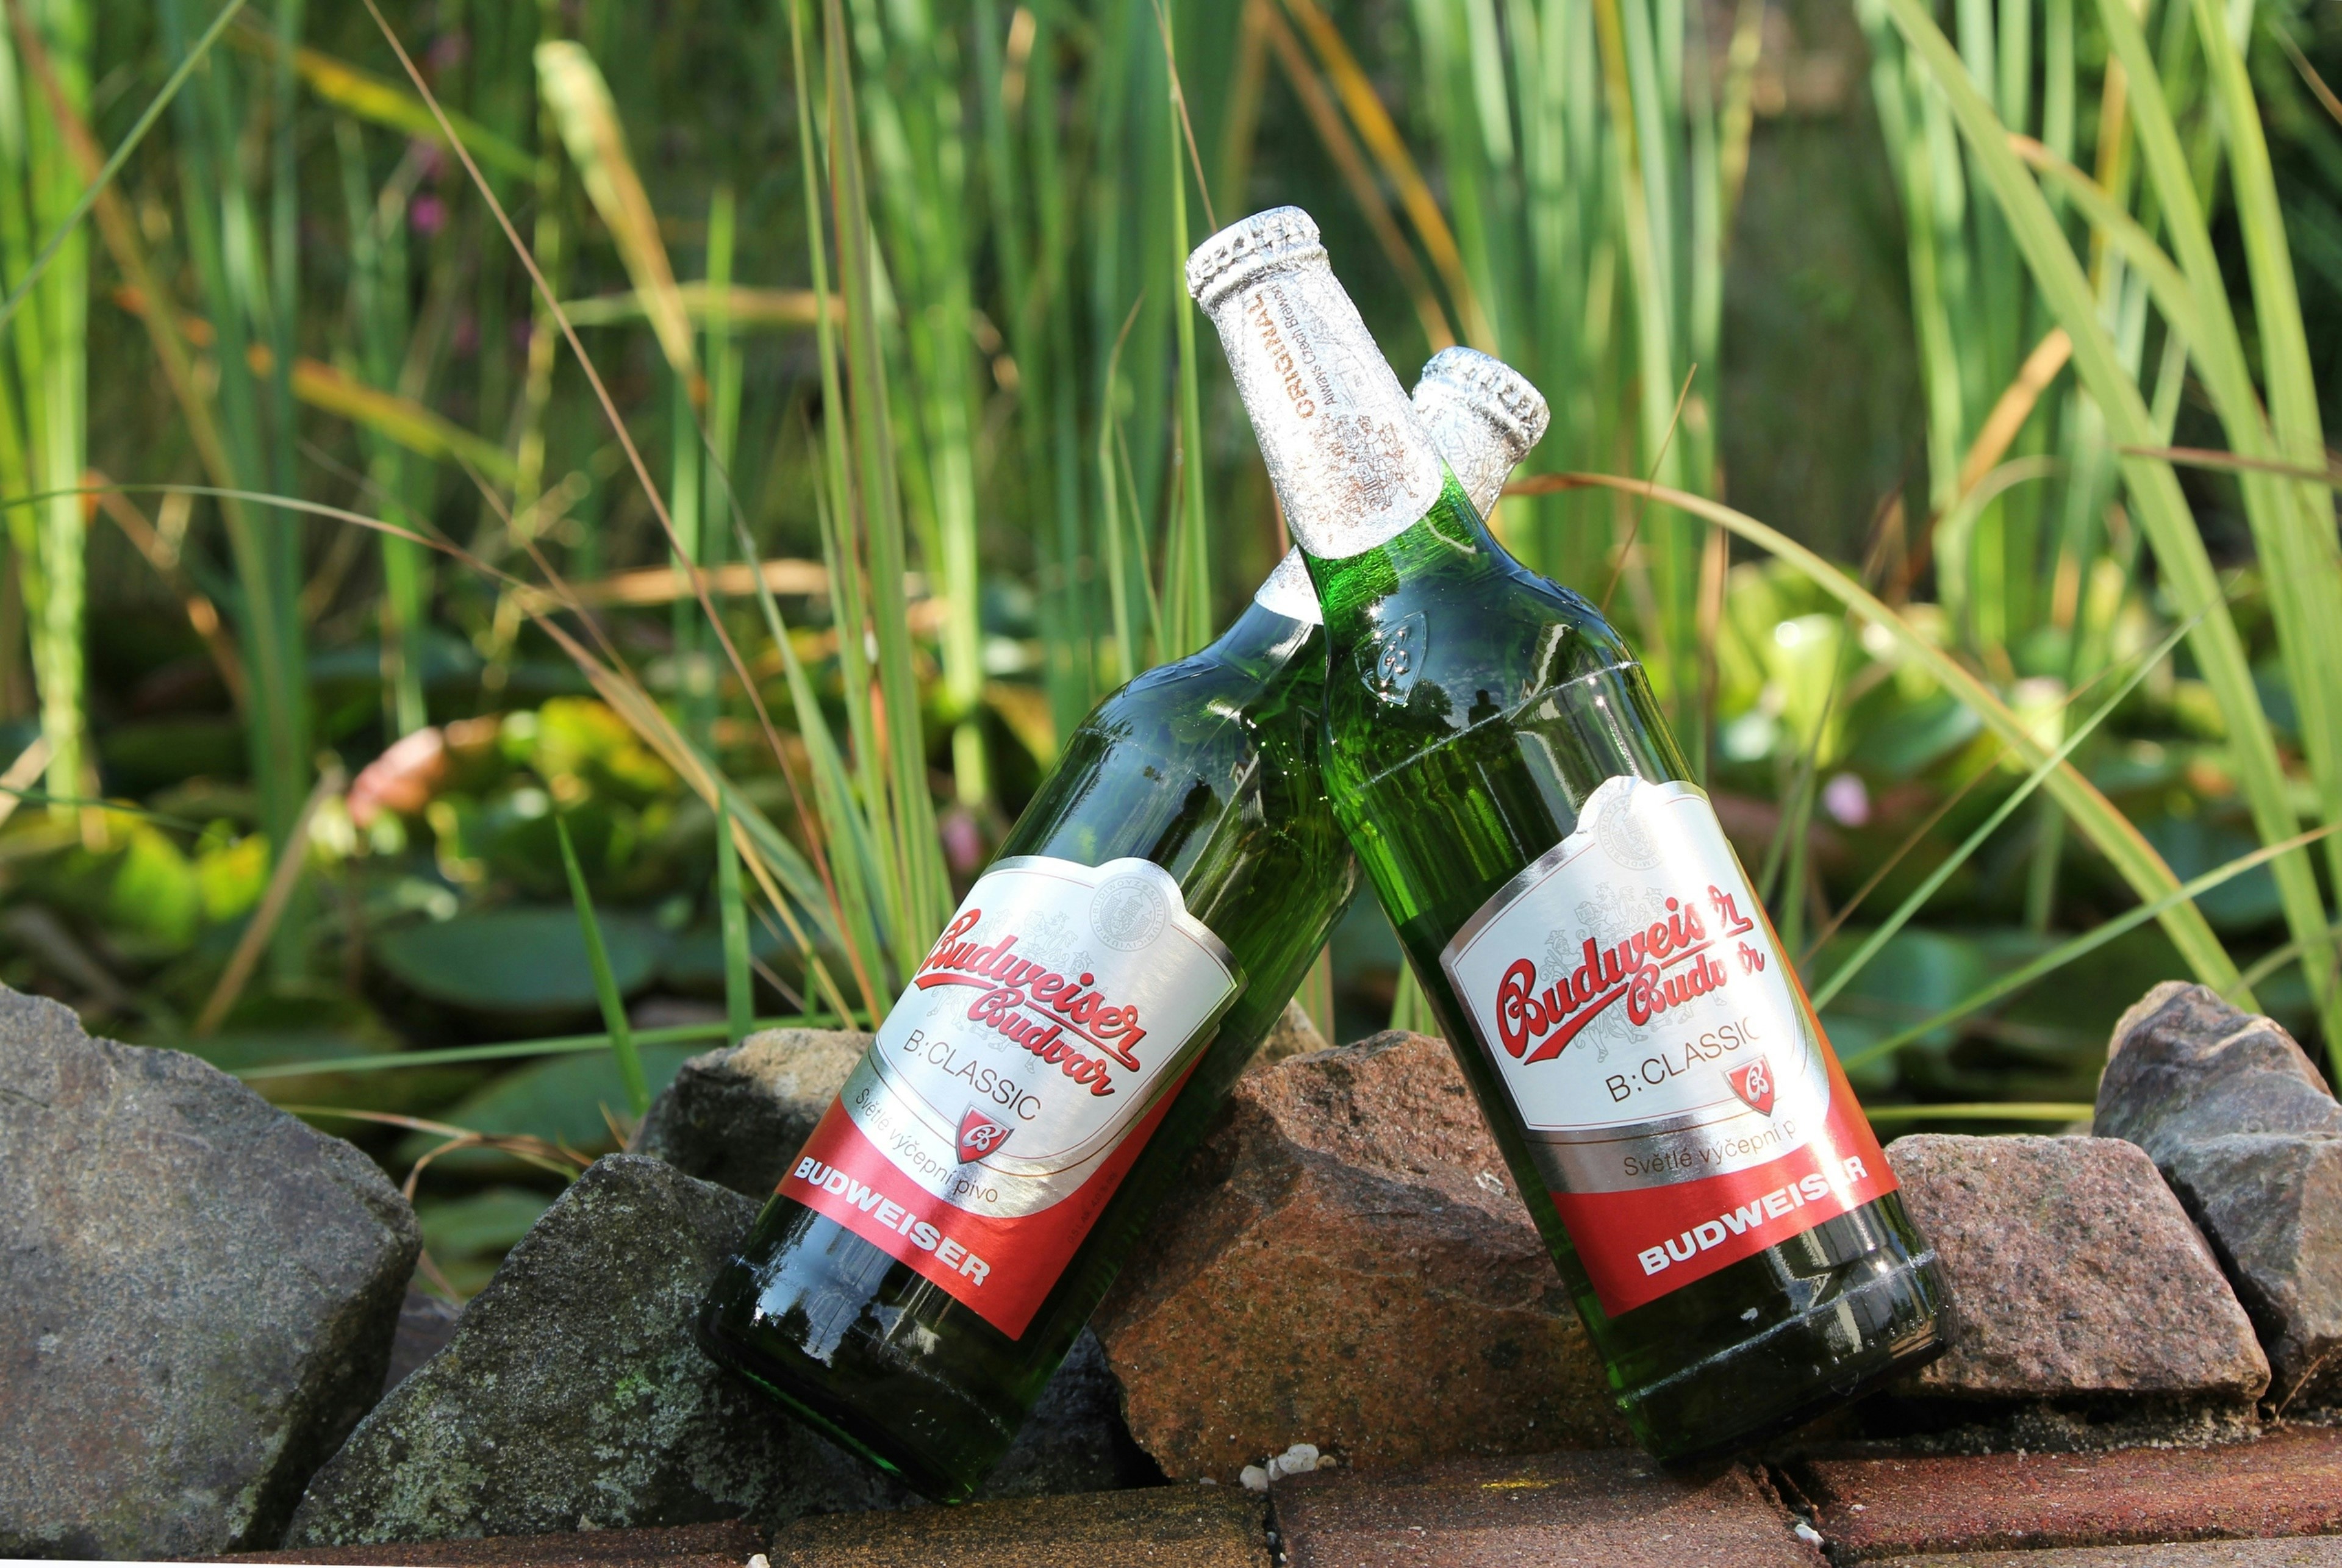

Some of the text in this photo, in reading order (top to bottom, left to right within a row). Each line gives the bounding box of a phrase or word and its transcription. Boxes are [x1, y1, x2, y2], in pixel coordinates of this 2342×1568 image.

[1247, 294, 1316, 419] ORIGINAL
[1291, 329, 1316, 365] Czech
[1311, 365, 1338, 406] Always
[1092, 879, 1163, 949] SIGILLUM CIVIUM DE BUDIWOYZ
[914, 908, 1148, 1072] Budweiser
[1496, 885, 1753, 1065] Budweisr
[1627, 940, 1764, 1026] Budvr
[967, 988, 1115, 1097] Budvar
[856, 1088, 998, 1203] Světlé výčepní pivo
[1624, 1148, 1692, 1176] Světlé
[1698, 1124, 1781, 1165] výčepní
[793, 1156, 990, 1287] BUDWEISER
[1637, 1155, 1868, 1276] BUDWEISR
